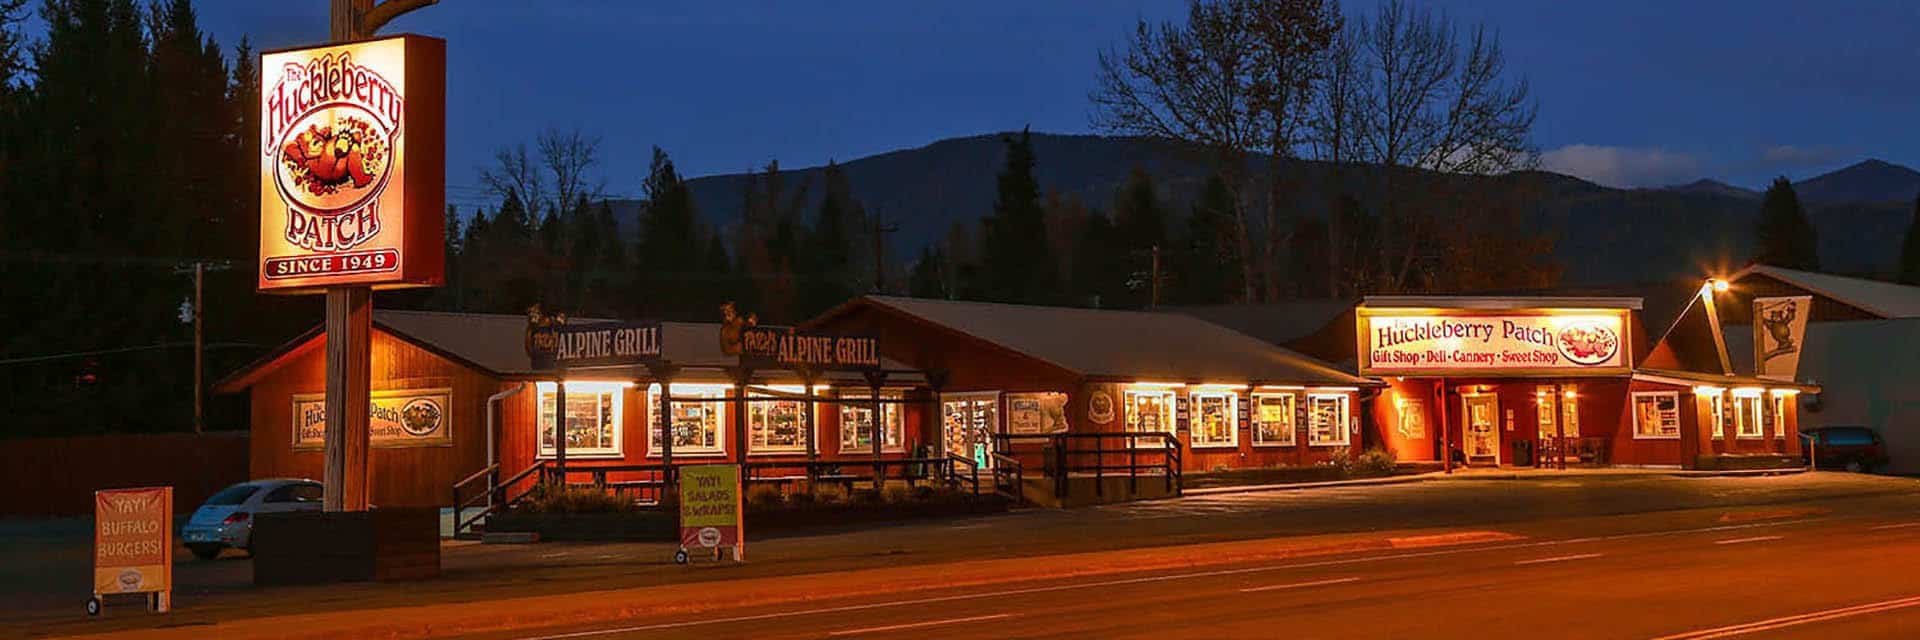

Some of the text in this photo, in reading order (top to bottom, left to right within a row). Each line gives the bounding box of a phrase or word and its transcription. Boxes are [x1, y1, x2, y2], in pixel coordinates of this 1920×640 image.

[286, 67, 301, 82] The
[267, 54, 402, 148] Huckleberry
[287, 203, 378, 248] PATCH
[277, 254, 386, 274] SINCE 1949
[556, 329, 612, 360] ALPINE
[614, 327, 661, 356] GRILL
[1378, 319, 1554, 349] Huckleberry Patch
[777, 334, 833, 363] ALPINE
[835, 336, 880, 365] GRILL
[1373, 350, 1559, 365] Gift Shop Deli Cannery Sweet Shop
[369, 402, 399, 423] Patch
[114, 498, 148, 513] YAY!
[102, 520, 158, 536] BUFFALO
[99, 540, 161, 558] BURGERS!
